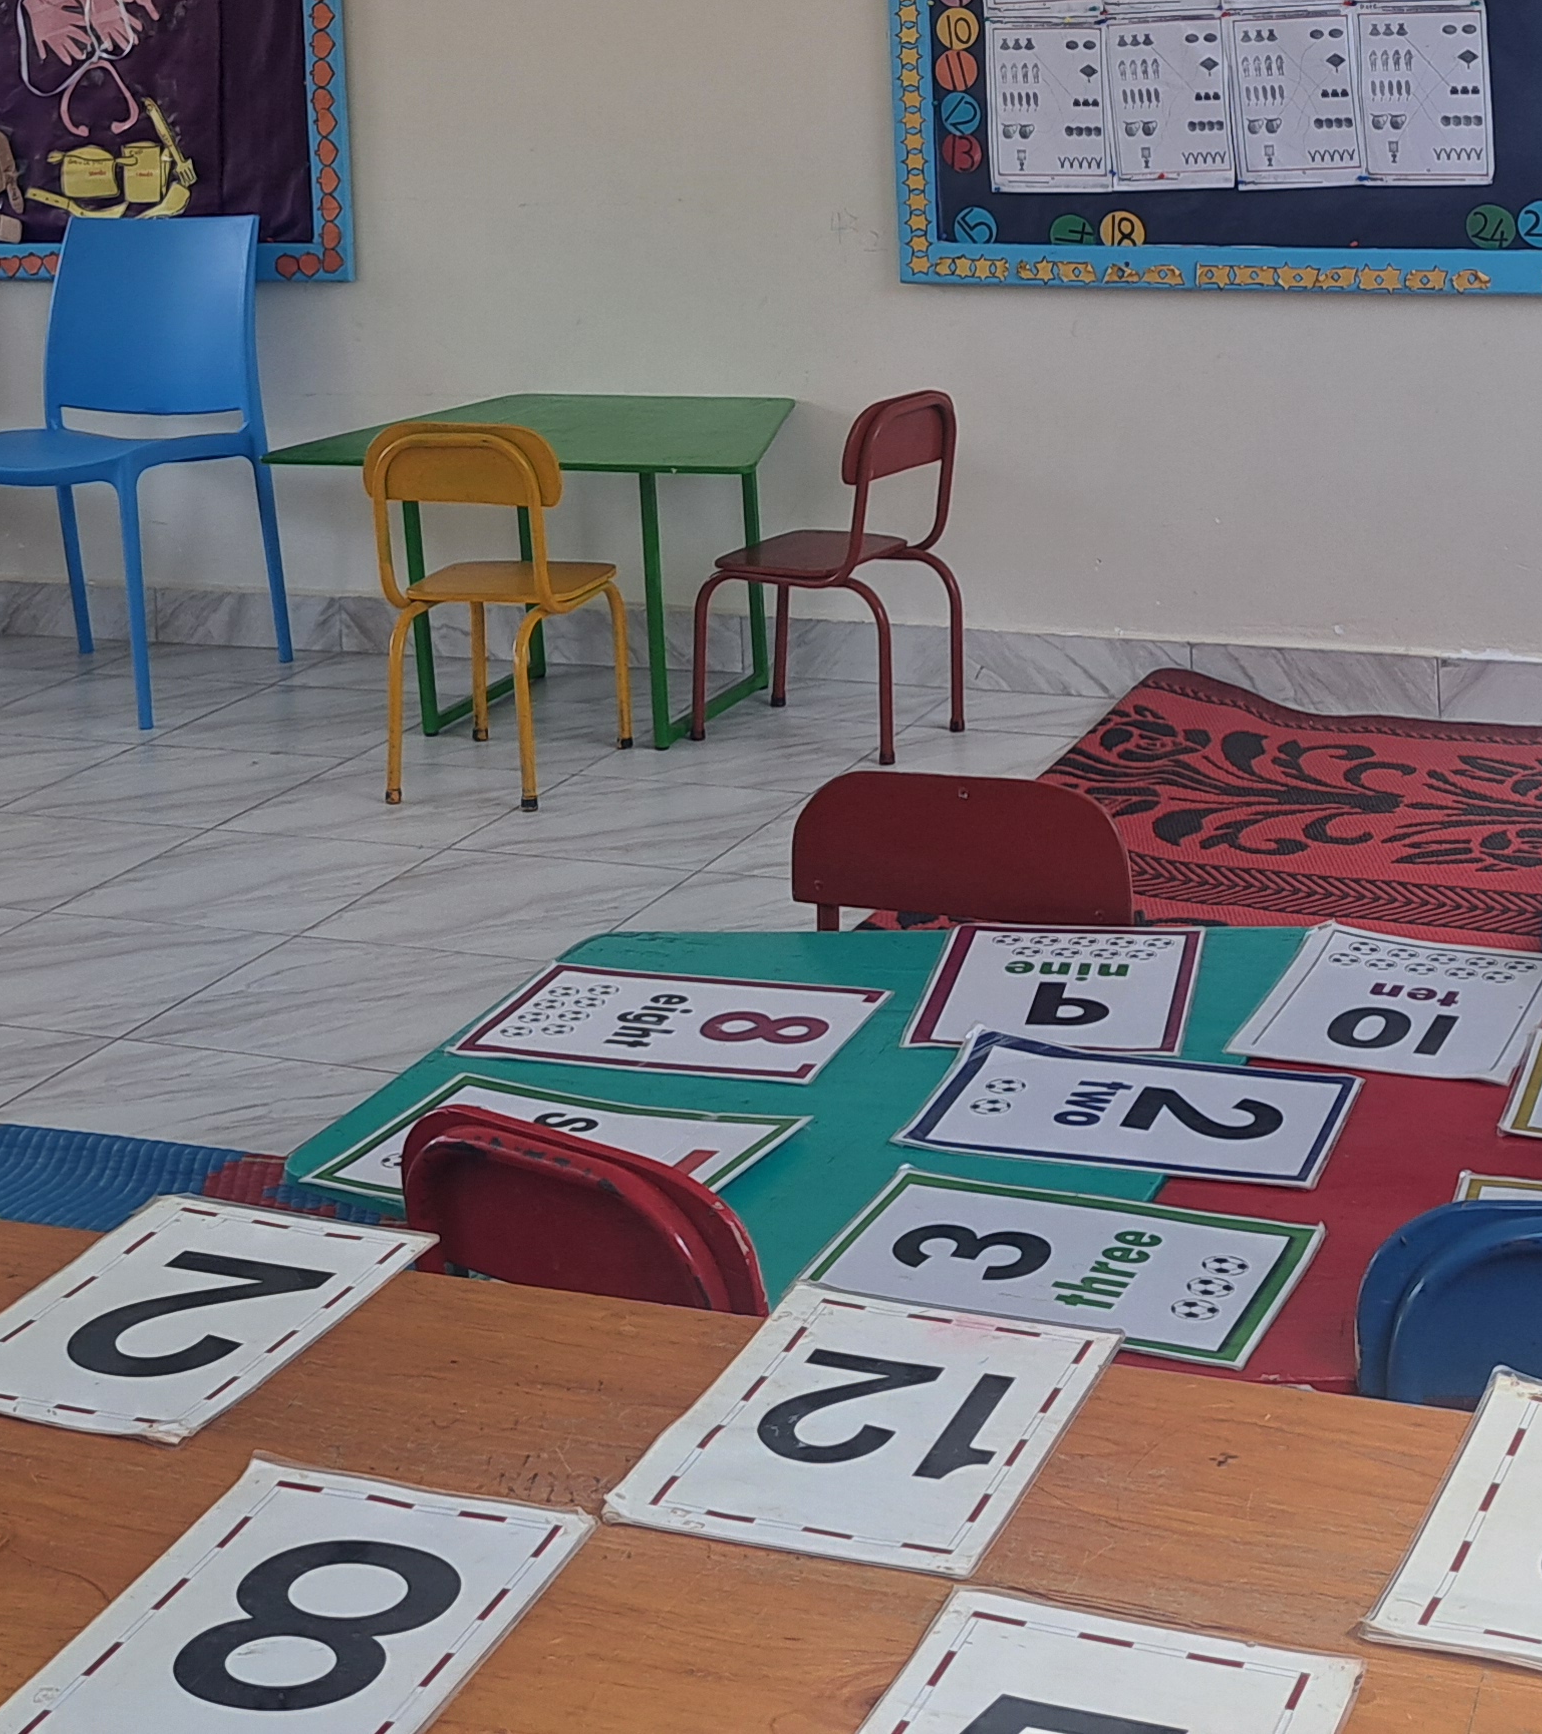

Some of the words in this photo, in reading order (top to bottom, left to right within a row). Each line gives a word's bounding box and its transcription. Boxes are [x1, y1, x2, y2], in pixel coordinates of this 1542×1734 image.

[946, 14, 973, 49] 10
[944, 51, 969, 90] 11
[944, 95, 978, 135] 12
[951, 134, 976, 173] 13
[1111, 214, 1138, 246] 18
[1471, 211, 1509, 249] 24
[1004, 958, 1131, 982] nine
[1024, 981, 1111, 1028] 9
[1369, 981, 1460, 1008] ten
[602, 992, 694, 1051] eight
[699, 1010, 830, 1045] 8
[1325, 1006, 1461, 1057] 10
[1053, 1078, 1135, 1128] two
[1118, 1085, 1285, 1142] 2
[891, 1221, 1053, 1282] 3
[1051, 1229, 1164, 1312] three
[65, 1249, 338, 1379] 2
[755, 1345, 1020, 1481] 12
[171, 1538, 463, 1713] 8
